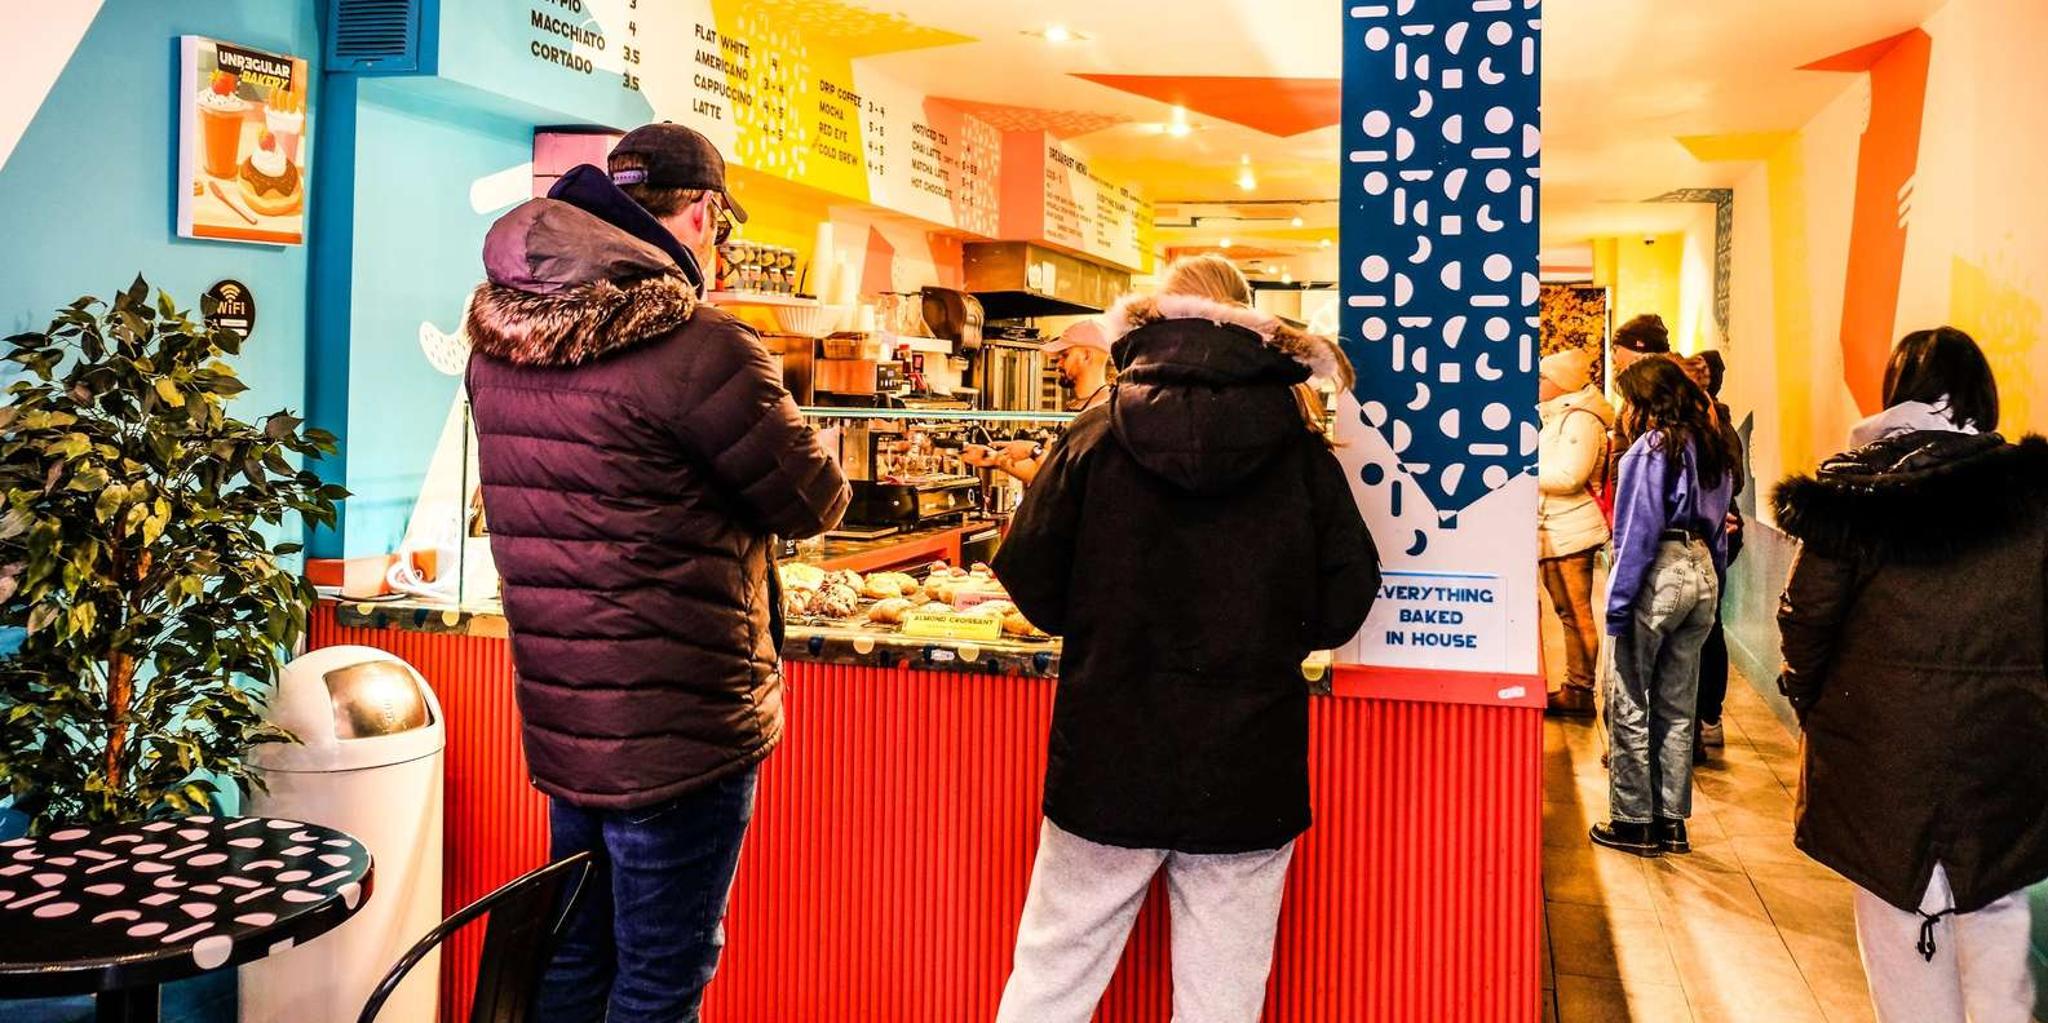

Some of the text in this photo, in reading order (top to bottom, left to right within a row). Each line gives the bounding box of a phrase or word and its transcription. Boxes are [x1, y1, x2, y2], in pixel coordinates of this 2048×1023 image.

[531, 10, 640, 65] MACCHIATO 3.5
[628, 21, 637, 37] 4
[695, 23, 717, 44] FLAT
[720, 35, 750, 59] WHITE
[531, 40, 640, 91] CORTADO 3.5
[695, 49, 749, 81] AMERICANO
[241, 70, 290, 90] BAKERY
[694, 74, 753, 107] CAPPUCCINO
[837, 87, 863, 108] COFFEE
[693, 98, 722, 121] LATTE
[819, 100, 844, 121] MOCHA
[949, 616, 993, 626] CROISSANT
[1399, 609, 1464, 625] BAKED
[1386, 631, 1478, 649] IN HOUSE
